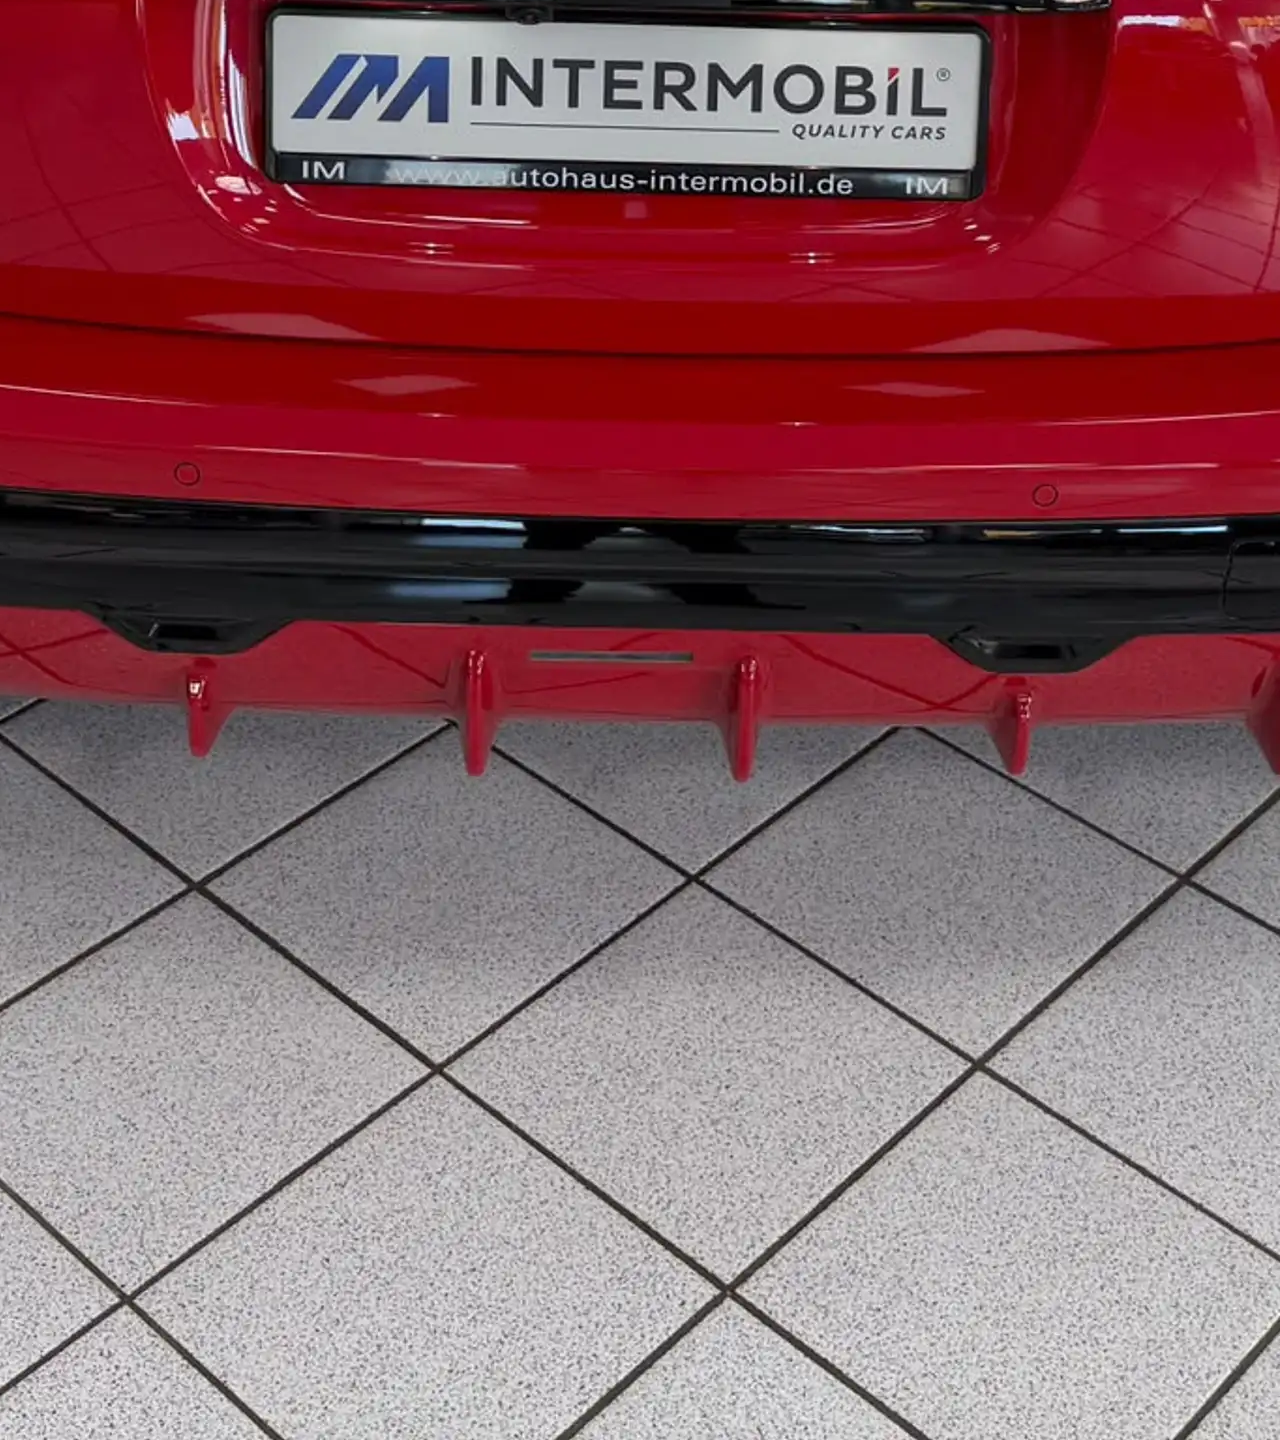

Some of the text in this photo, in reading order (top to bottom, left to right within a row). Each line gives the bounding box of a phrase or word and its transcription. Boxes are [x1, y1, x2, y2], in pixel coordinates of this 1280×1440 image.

[792, 123, 947, 141] QUALITY CARS
[302, 161, 949, 196] IM www.autohaus-intermobil.de IM
